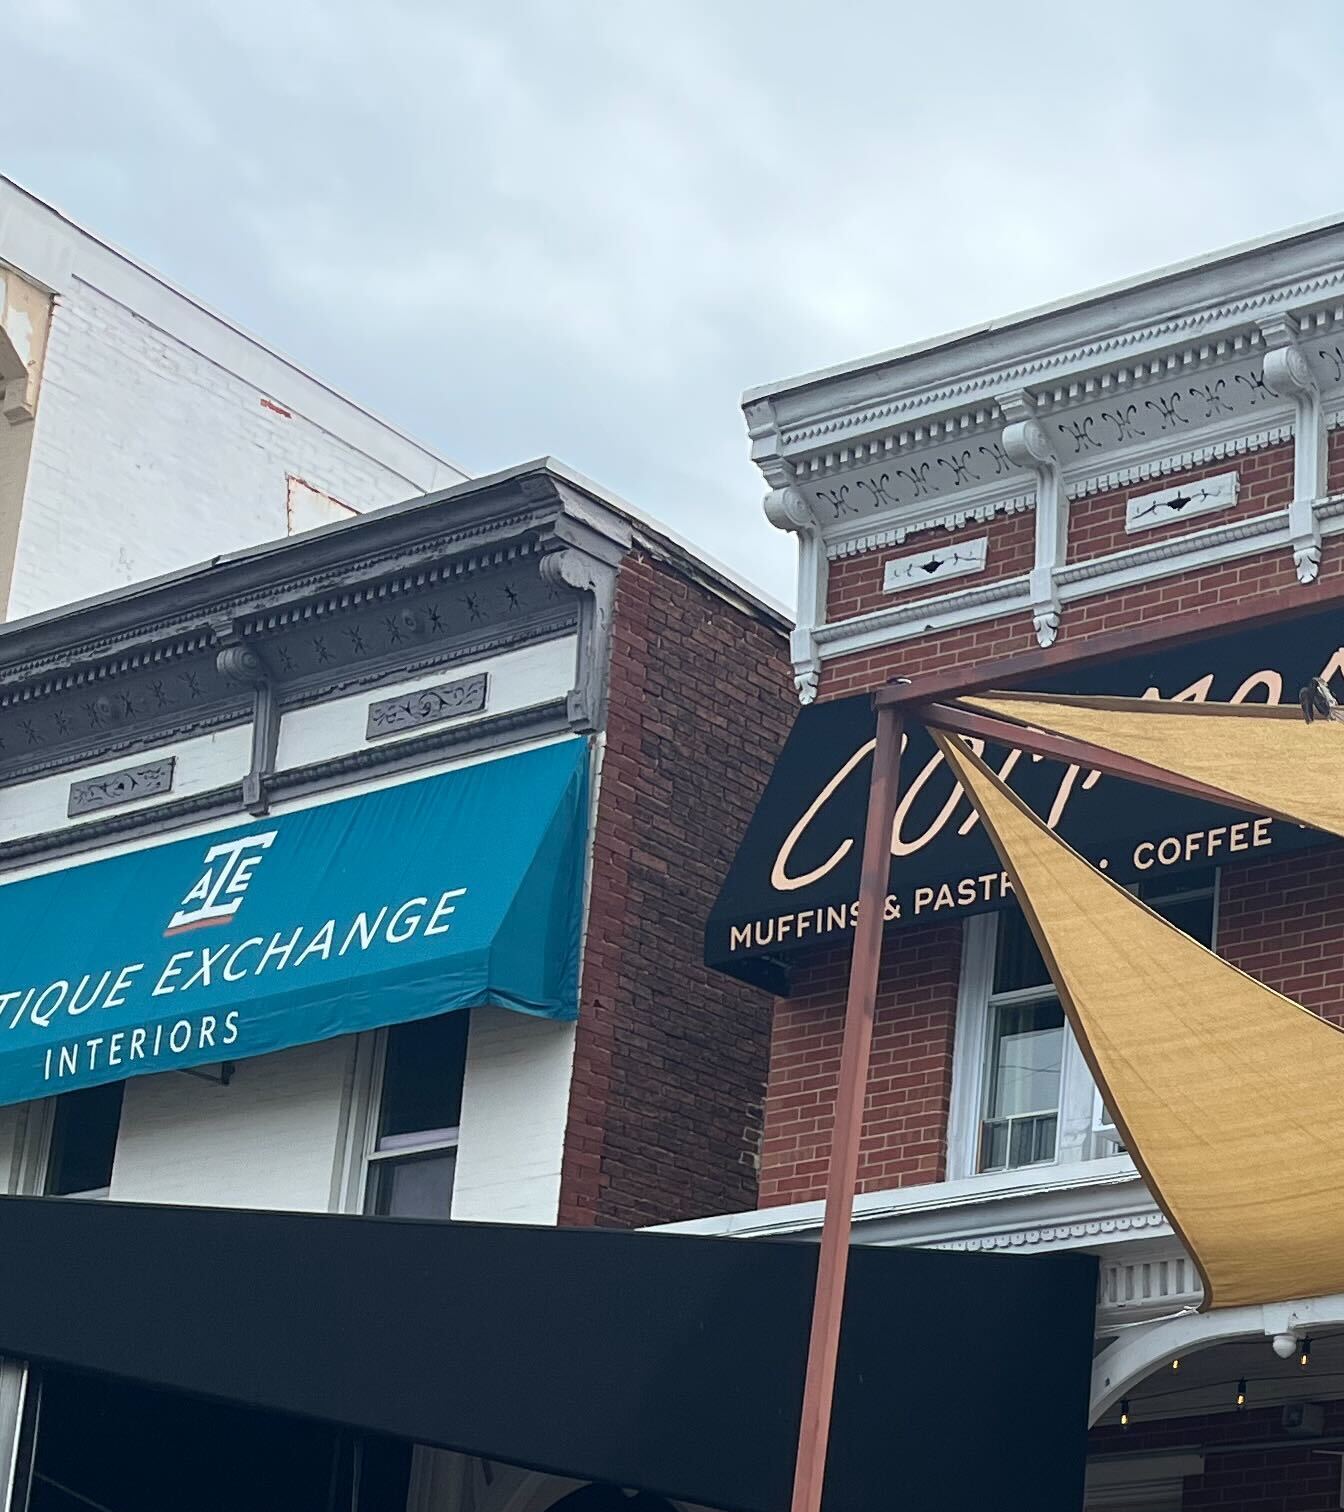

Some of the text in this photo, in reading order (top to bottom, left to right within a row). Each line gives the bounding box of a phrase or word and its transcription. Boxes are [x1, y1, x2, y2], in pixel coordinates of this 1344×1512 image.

[881, 892, 904, 921] &
[1132, 818, 1272, 870] COFFEE
[151, 888, 467, 996] EXCHANGE
[44, 1011, 240, 1080] INTERIORS
